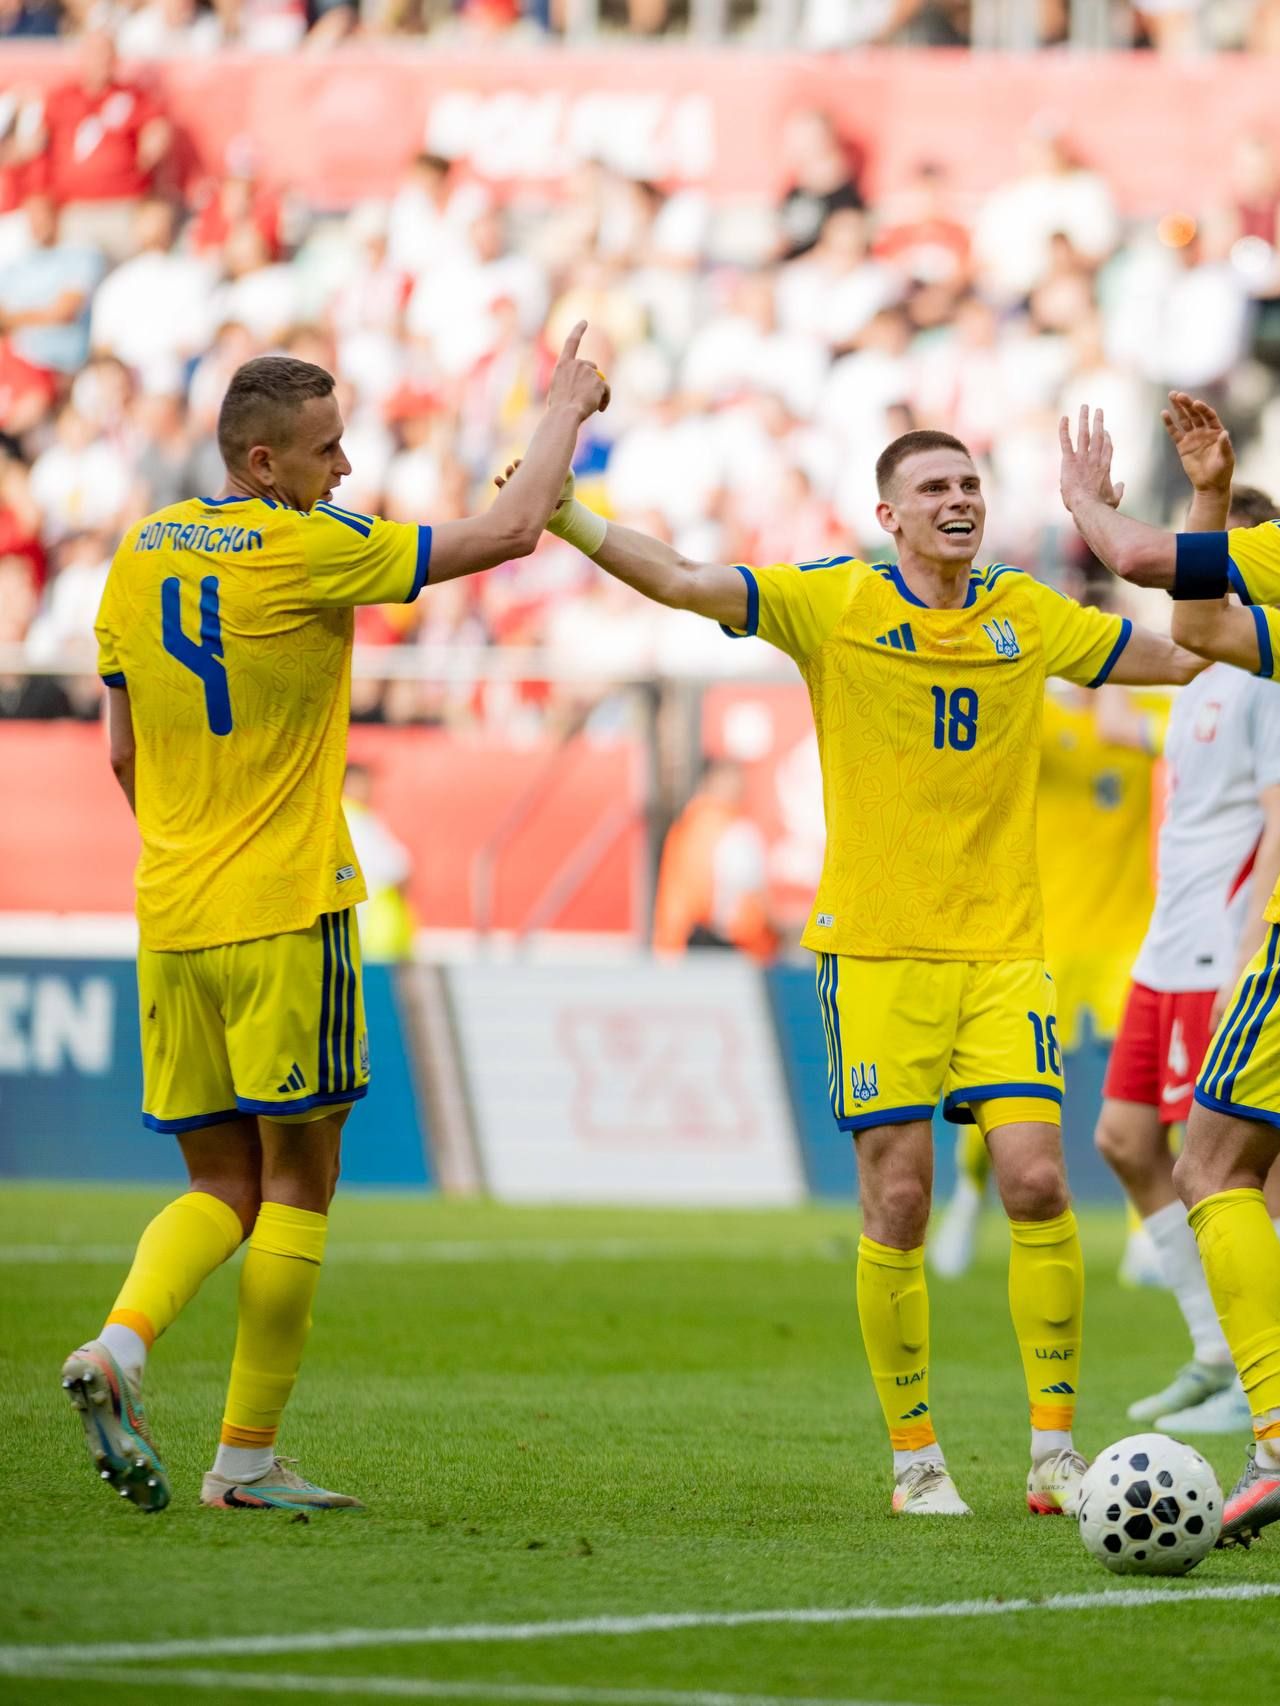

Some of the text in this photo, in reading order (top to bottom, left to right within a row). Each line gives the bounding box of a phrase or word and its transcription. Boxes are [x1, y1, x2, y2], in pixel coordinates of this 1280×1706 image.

[161, 575, 233, 736] 4
[930, 685, 978, 751] 18
[1035, 1348, 1075, 1360] UAF
[895, 1366, 927, 1387] UAF
